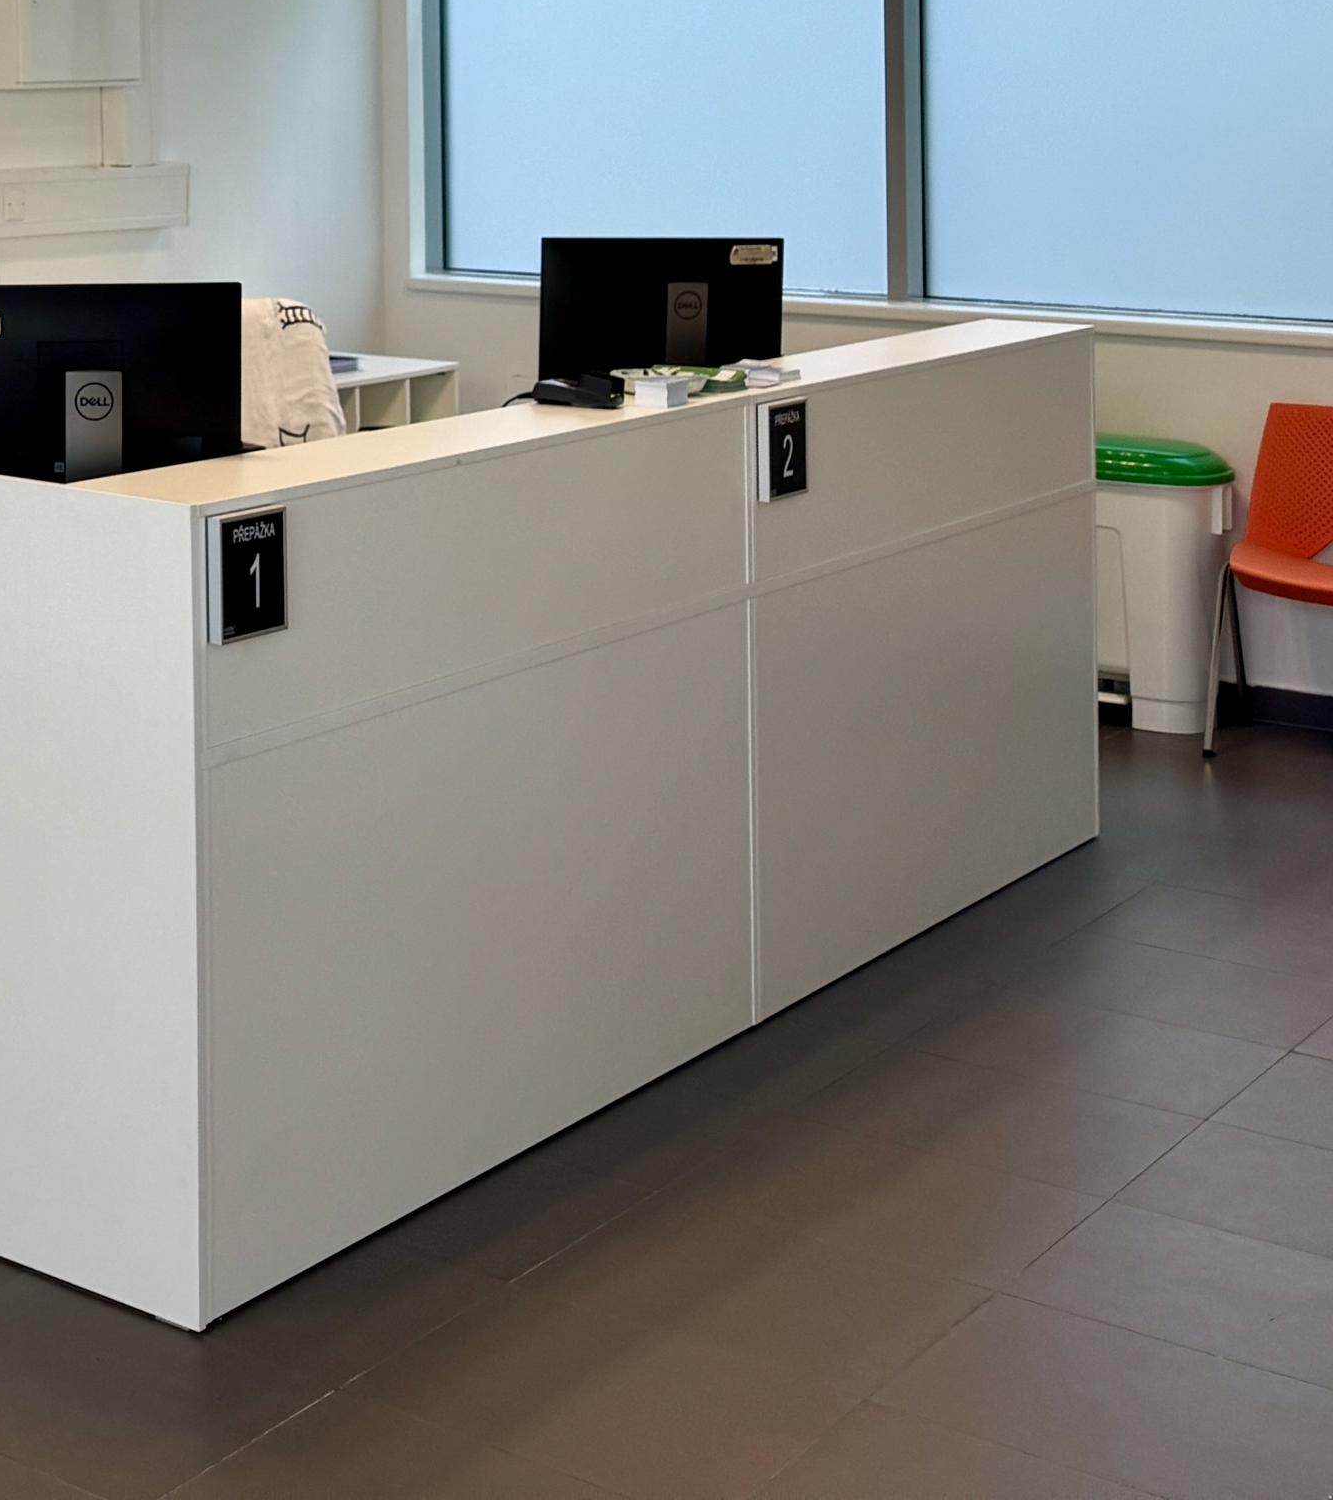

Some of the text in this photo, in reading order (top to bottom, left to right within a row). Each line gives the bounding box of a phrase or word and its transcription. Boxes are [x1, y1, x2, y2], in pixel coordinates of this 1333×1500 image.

[79, 397, 110, 407] DELL
[783, 433, 794, 478] 2
[233, 521, 275, 542] PŘEPÁŽKA
[249, 552, 261, 609] 1
